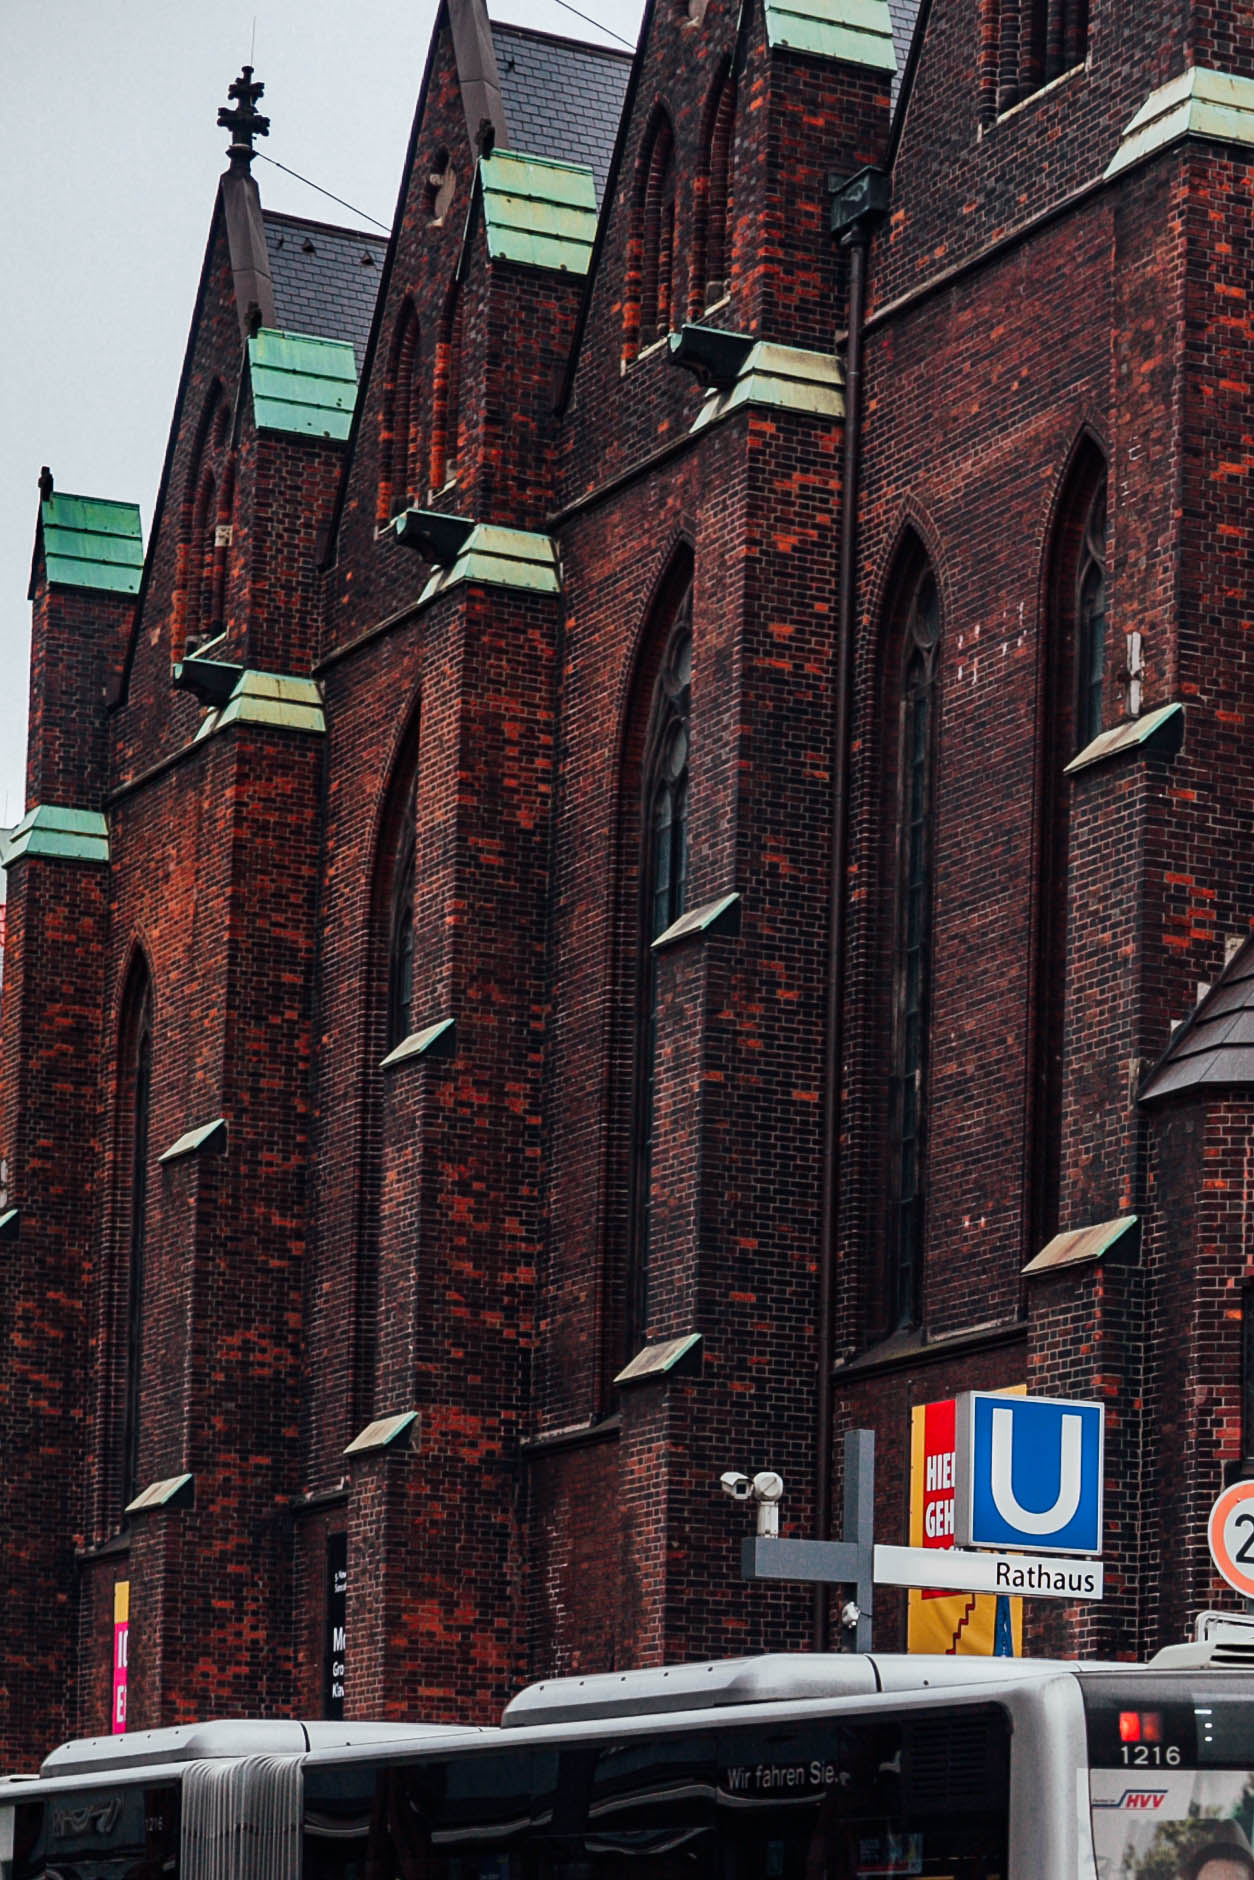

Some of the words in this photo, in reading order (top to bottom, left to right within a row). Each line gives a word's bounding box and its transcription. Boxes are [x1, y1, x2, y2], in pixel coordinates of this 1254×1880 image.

[990, 1407, 1083, 1535] U
[996, 1561, 1095, 1593] Rathaus
[1120, 1745, 1181, 1765] 1216
[728, 1767, 751, 1790] Wir
[756, 1764, 805, 1789] fahren
[809, 1760, 839, 1785] Sie.
[1125, 1794, 1165, 1808] HVV
